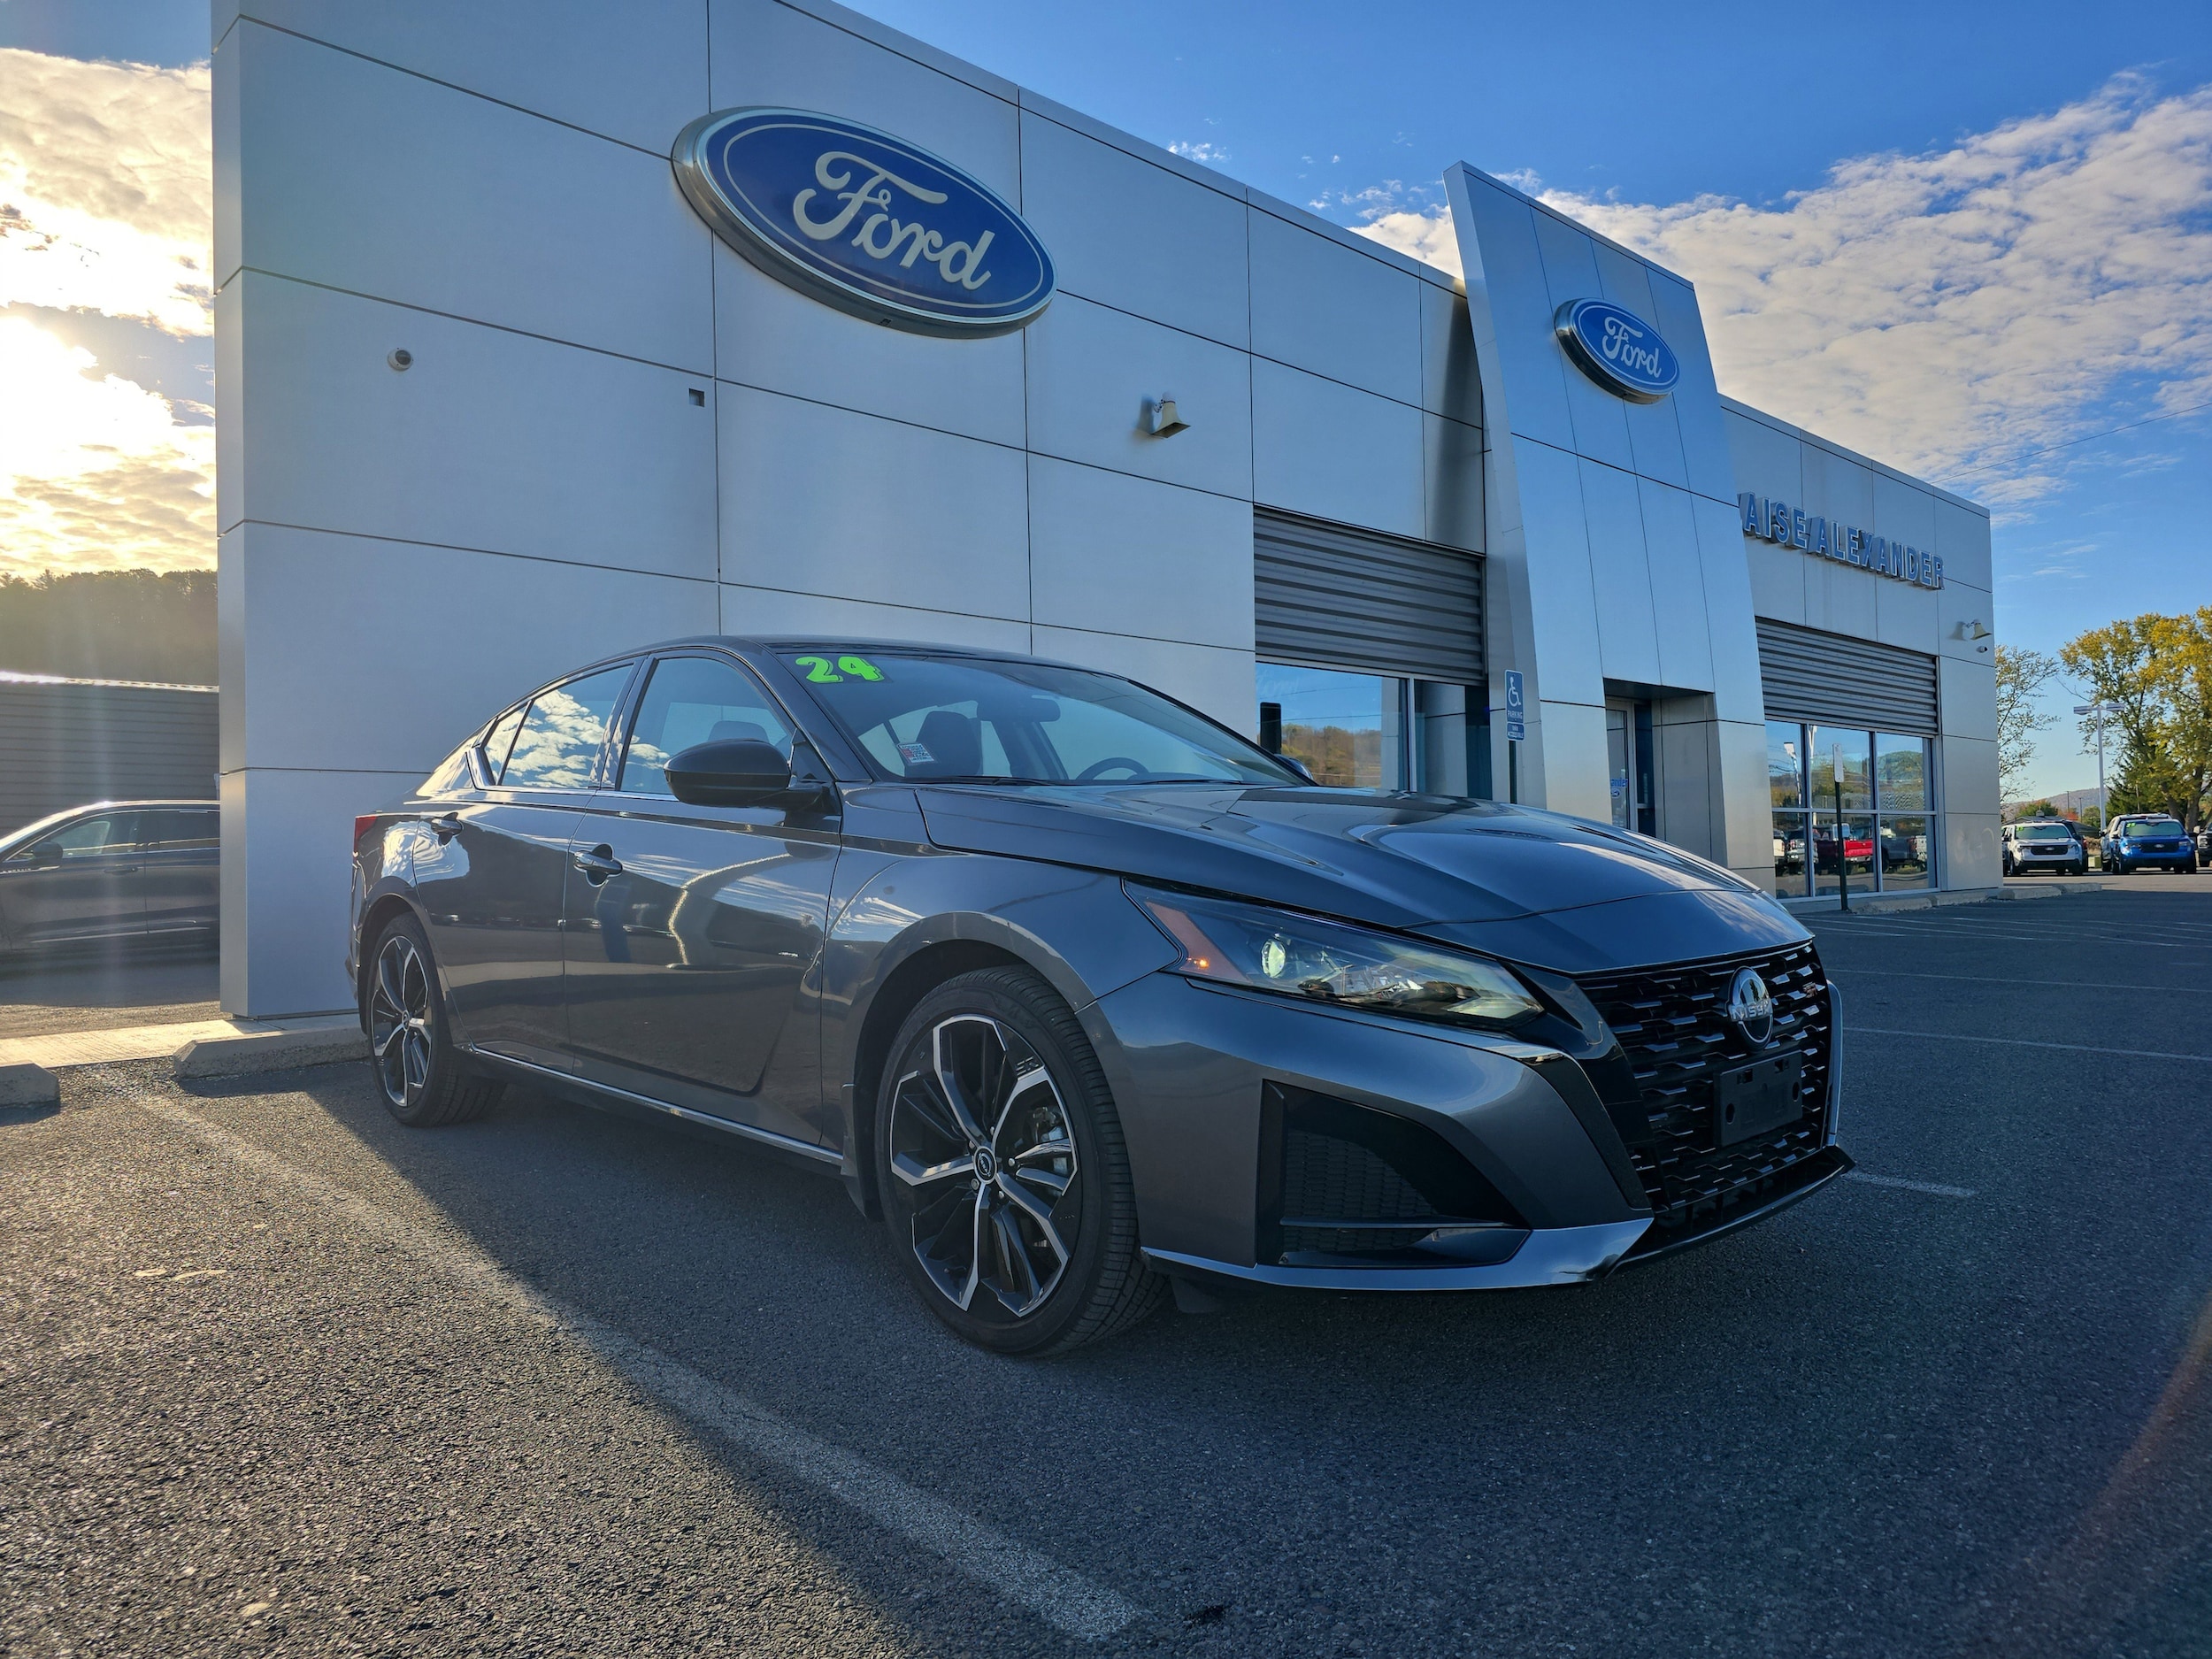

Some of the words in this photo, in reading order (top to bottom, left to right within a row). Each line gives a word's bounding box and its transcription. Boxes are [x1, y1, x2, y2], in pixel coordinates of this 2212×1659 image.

[793, 151, 995, 290] Ford
[1601, 316, 1662, 378] Ford
[1808, 516, 1945, 590] ALEXANDER
[795, 656, 885, 684] 24
